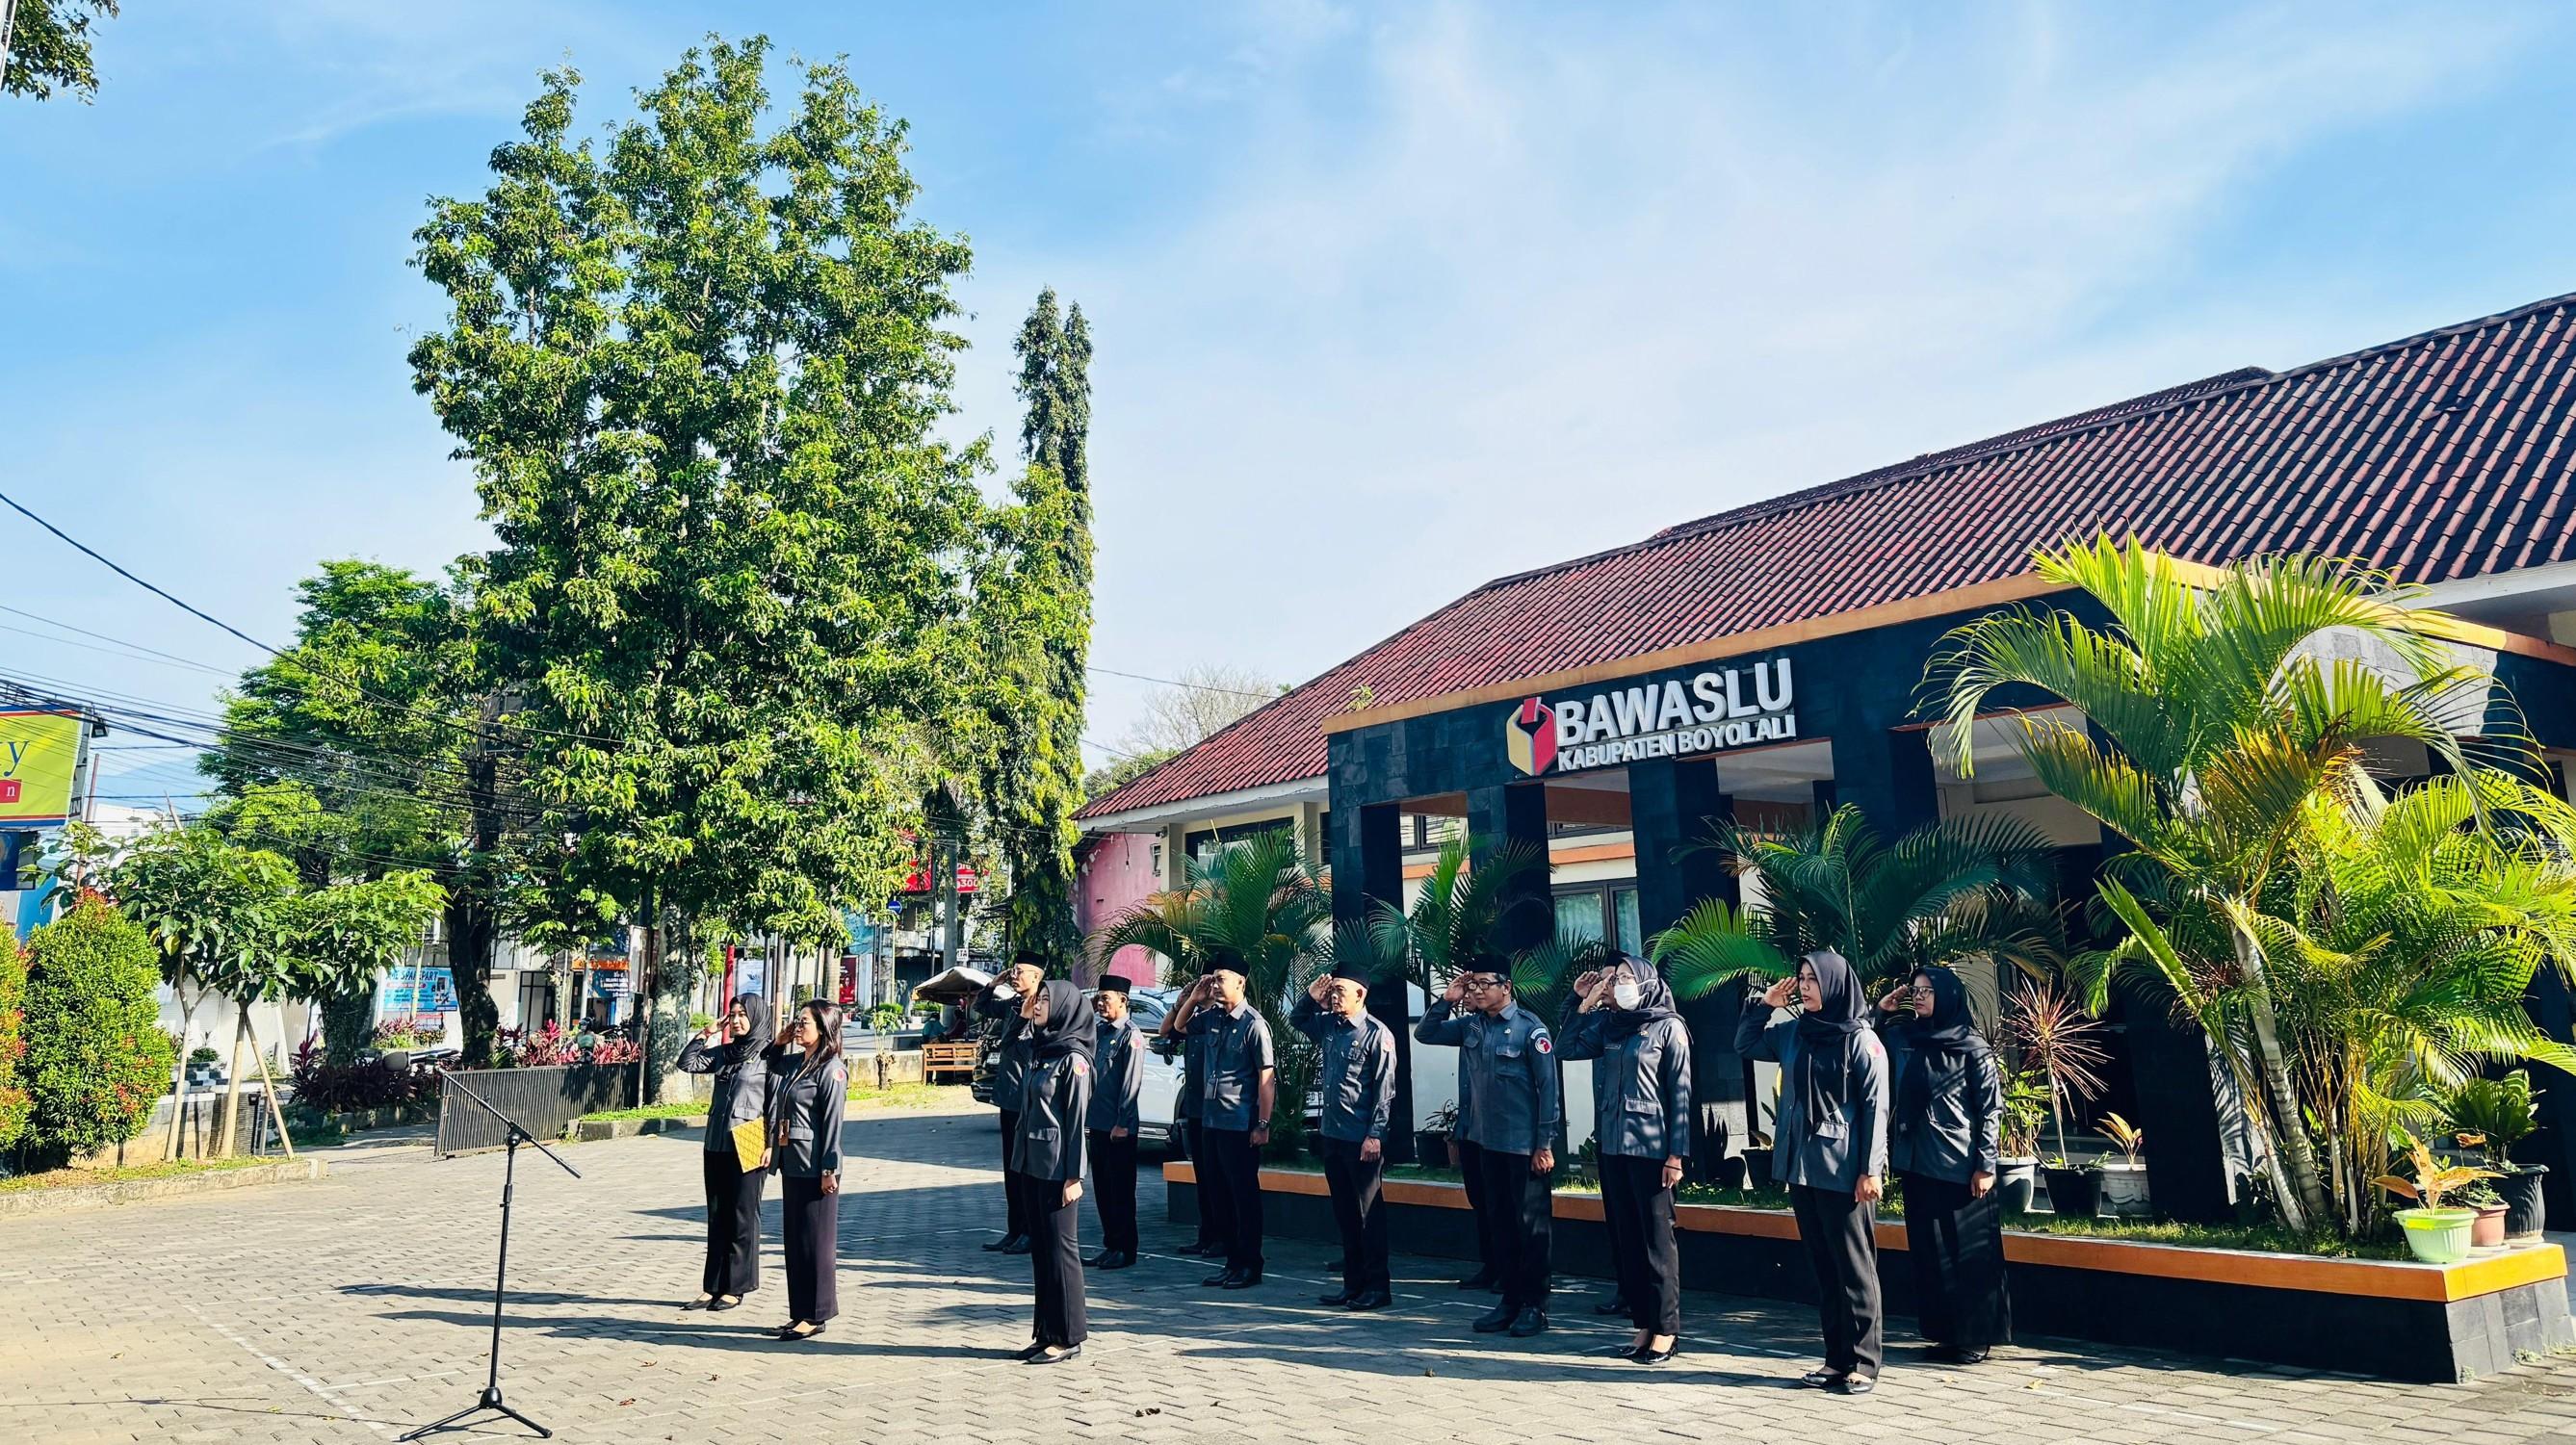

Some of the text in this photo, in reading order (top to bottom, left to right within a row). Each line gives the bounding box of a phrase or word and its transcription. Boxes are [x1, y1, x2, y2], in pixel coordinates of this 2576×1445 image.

[1555, 658, 1793, 747] BAWASLU
[1557, 714, 1797, 771] KABUPATEN BOYOLALI
